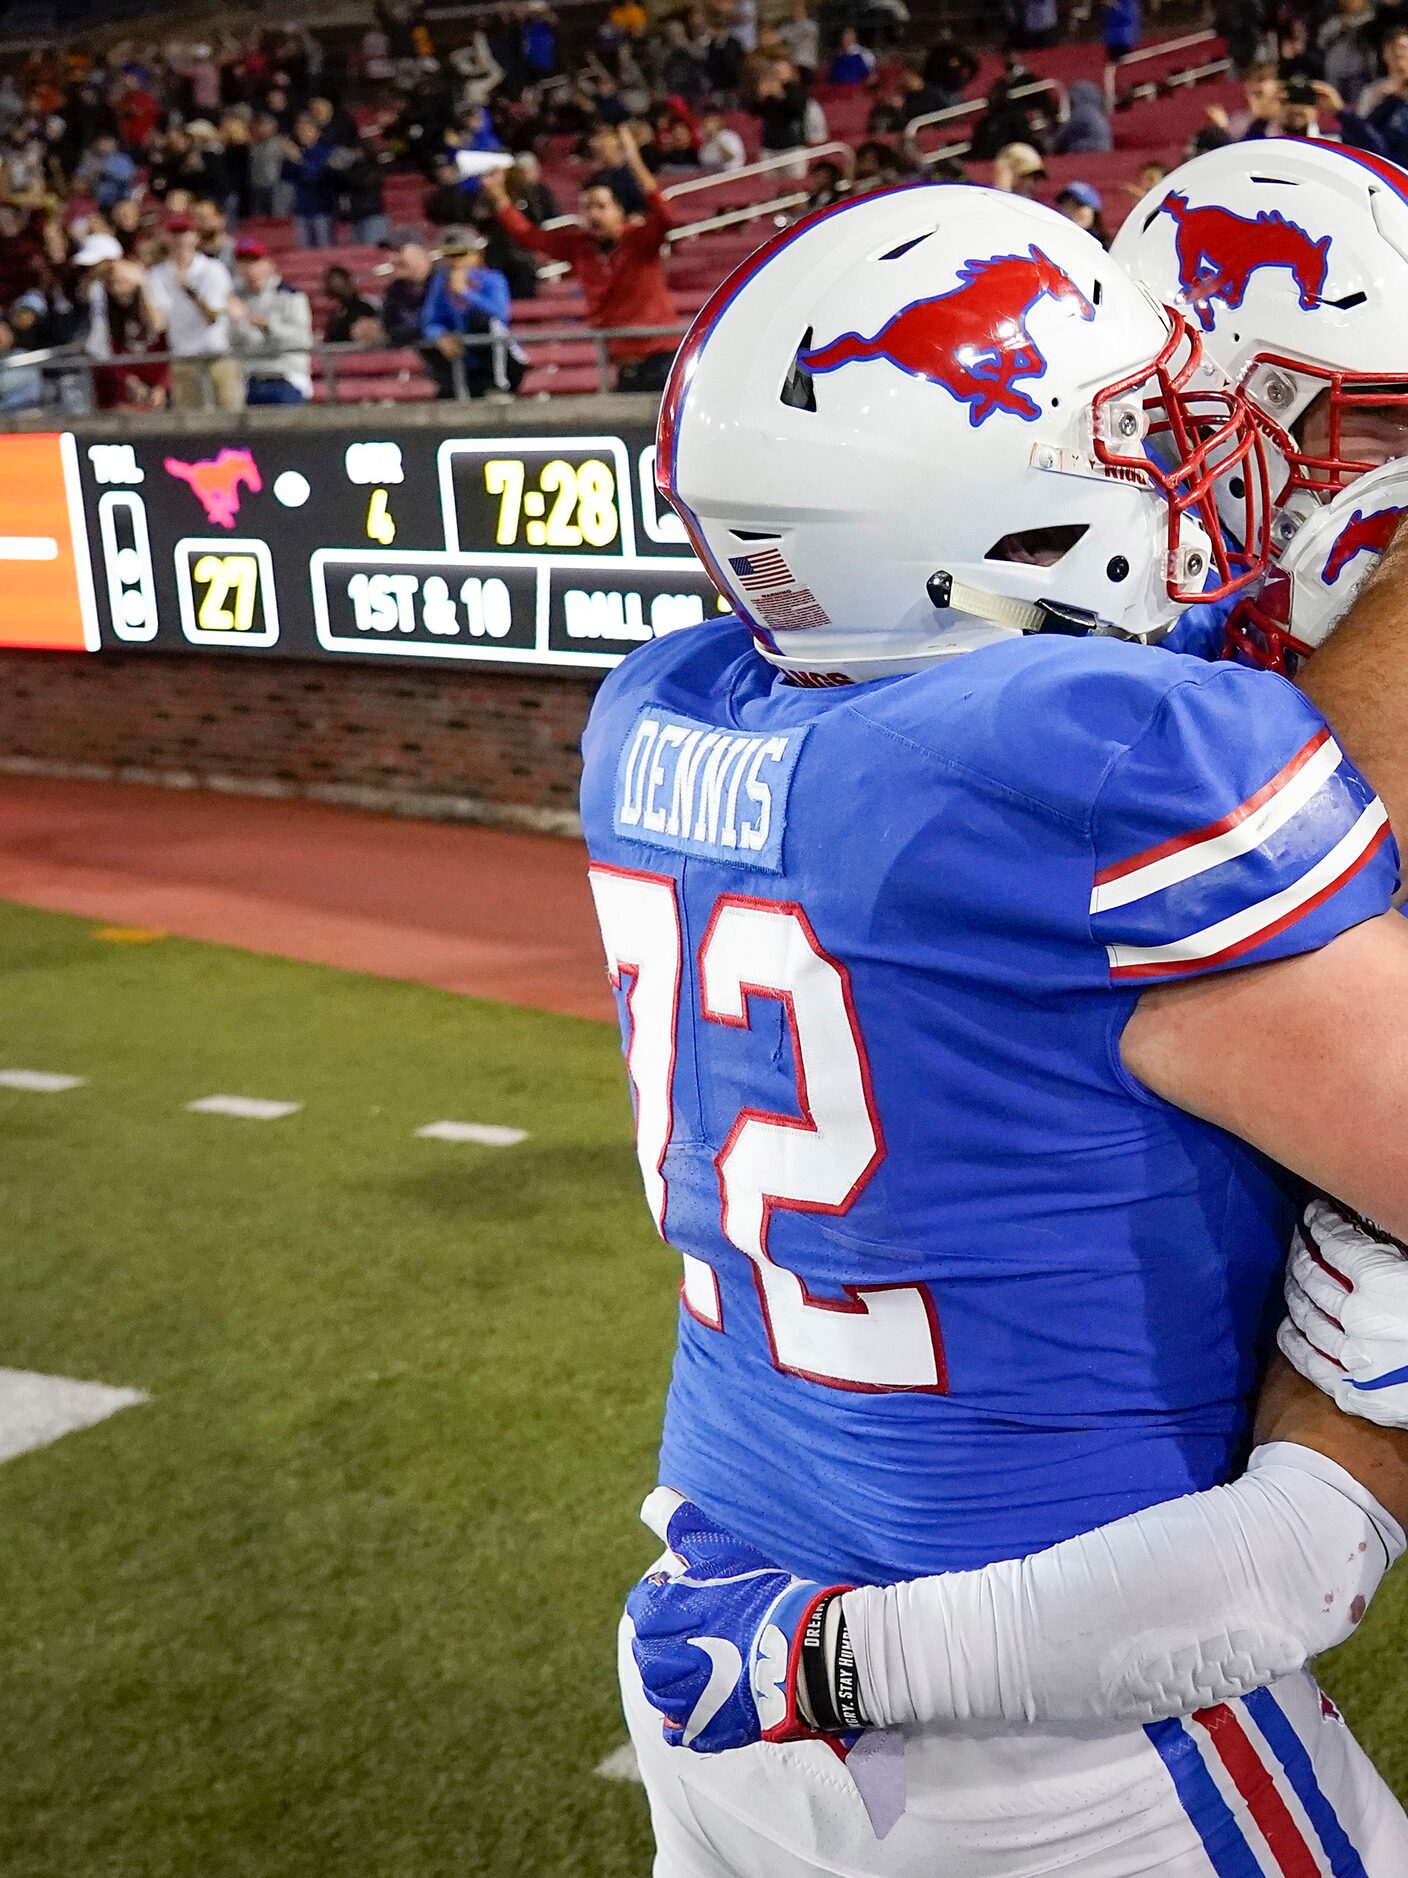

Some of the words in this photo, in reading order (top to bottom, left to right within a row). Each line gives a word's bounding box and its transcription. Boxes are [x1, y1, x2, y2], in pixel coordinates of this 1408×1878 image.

[366, 488, 396, 545] 4
[484, 458, 619, 547] 7:28
[193, 555, 259, 630] 27
[346, 573, 418, 636] 1ST
[421, 575, 460, 637] &
[460, 576, 513, 638] 10
[620, 719, 790, 851] DENNIS
[588, 860, 950, 1395] 72
[838, 1669, 853, 1699] STAY
